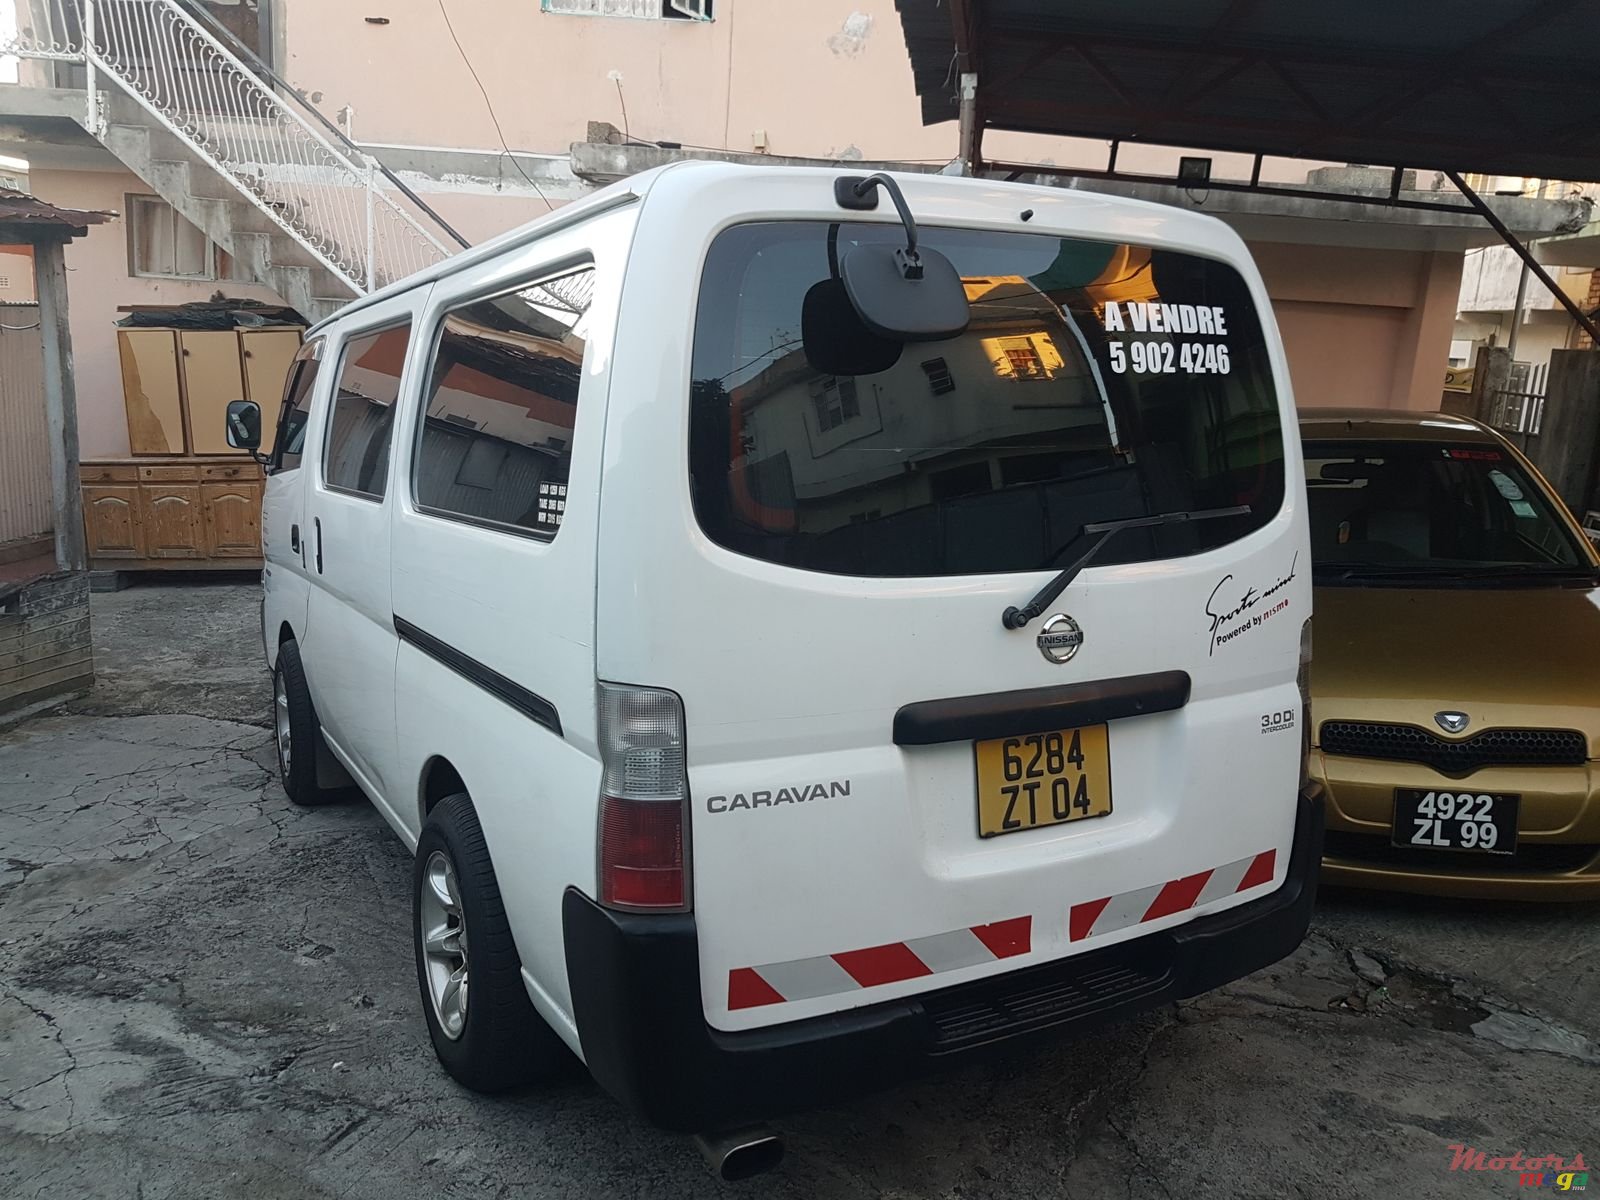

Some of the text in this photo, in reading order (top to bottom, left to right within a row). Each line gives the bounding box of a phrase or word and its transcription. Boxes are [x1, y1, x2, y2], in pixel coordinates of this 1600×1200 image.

[1105, 301, 1228, 336] A VENDRE
[1109, 341, 1231, 375] 5 902 4246
[1043, 633, 1081, 645] NISSAN
[1216, 619, 1252, 646] Powered
[1252, 614, 1262, 626] by
[1261, 721, 1295, 735] INTERCOOLER
[1002, 729, 1085, 782] 6284
[706, 780, 851, 814] CARAVAN
[1001, 773, 1091, 830] ZT 04
[1417, 792, 1494, 822] 4922
[1410, 818, 1498, 849] ZL 99
